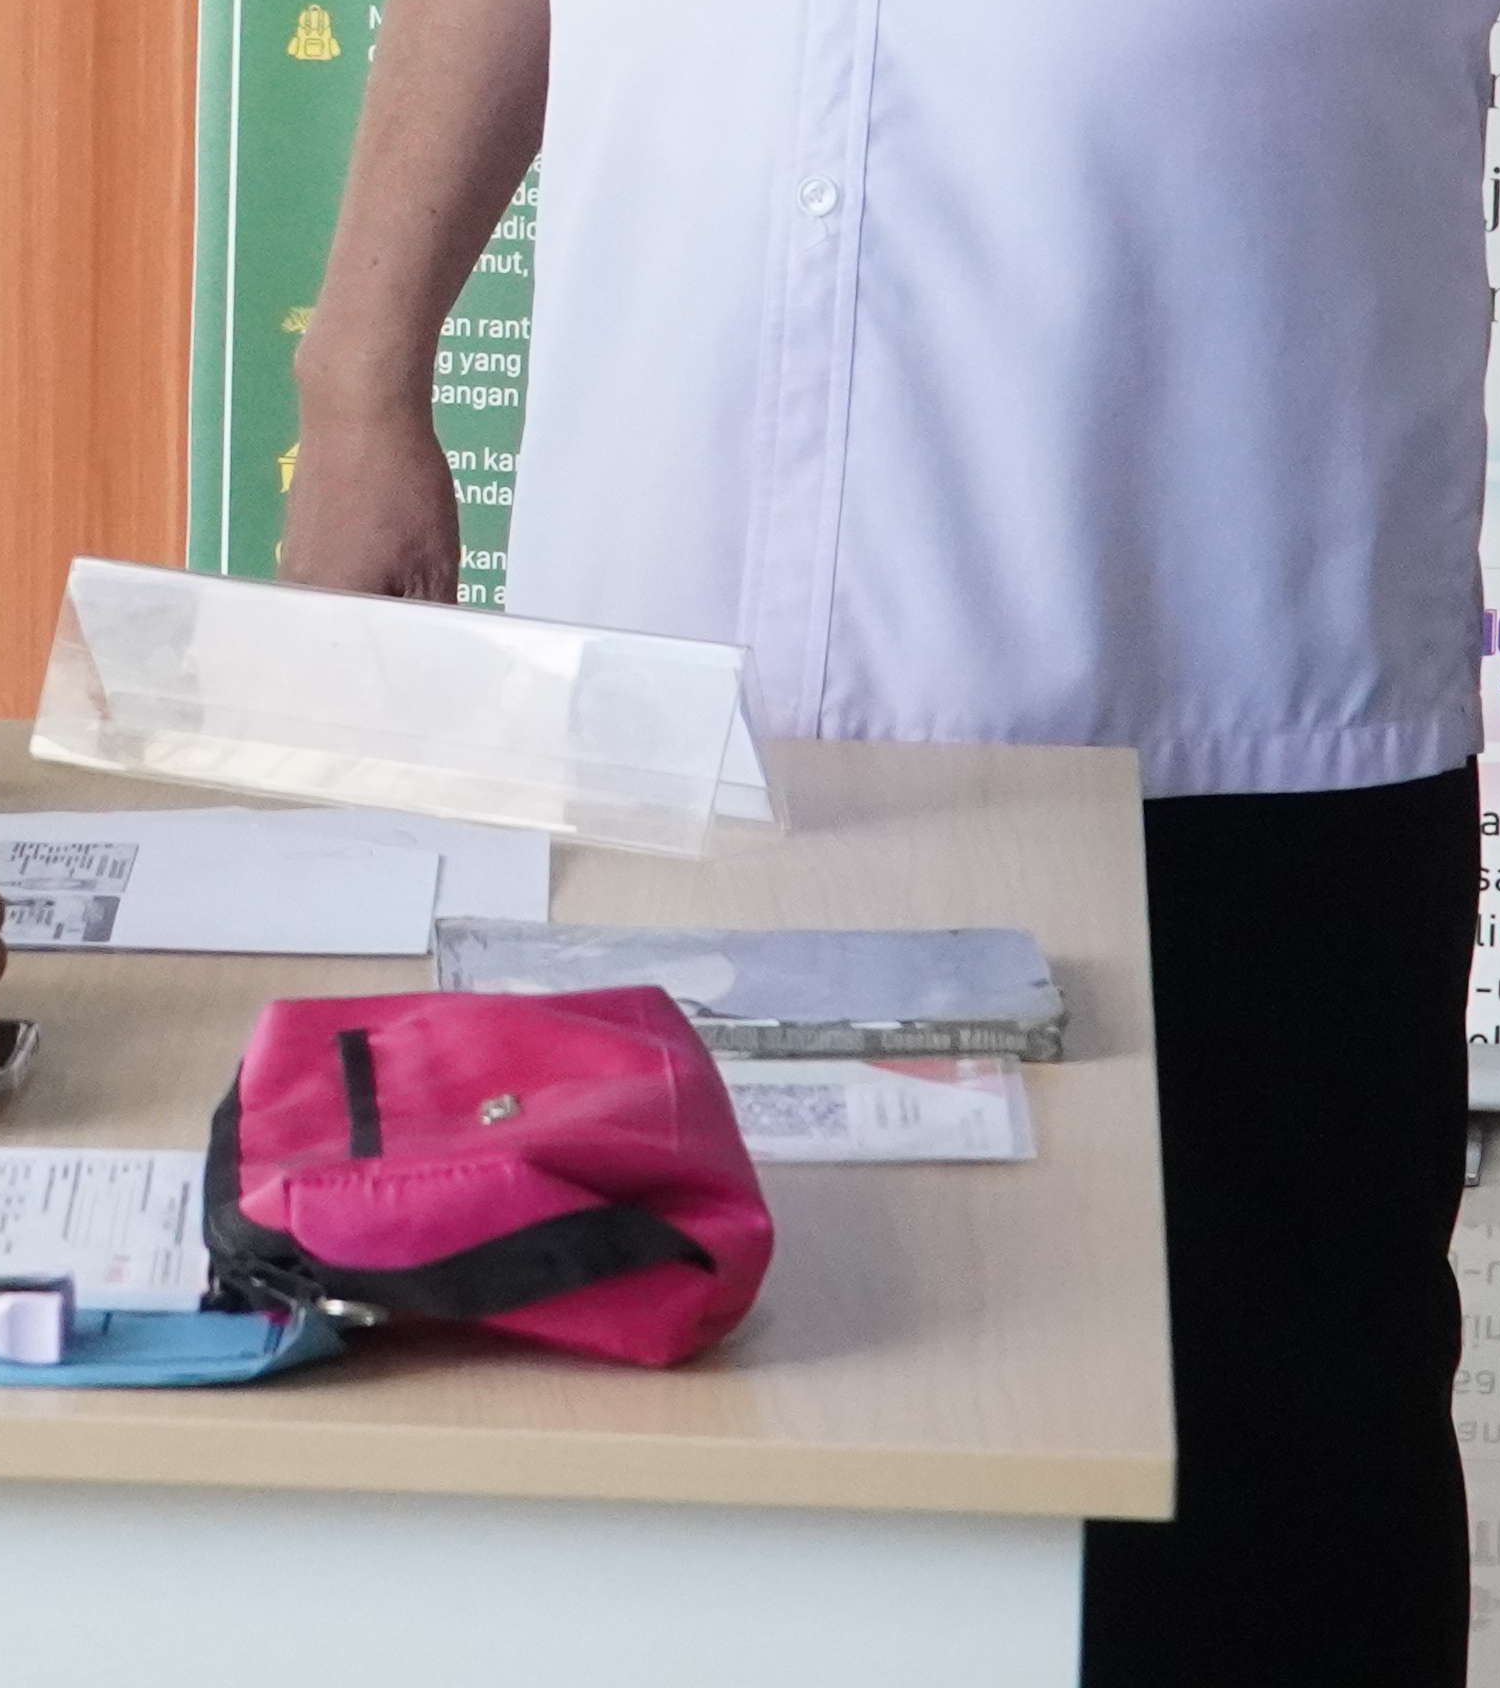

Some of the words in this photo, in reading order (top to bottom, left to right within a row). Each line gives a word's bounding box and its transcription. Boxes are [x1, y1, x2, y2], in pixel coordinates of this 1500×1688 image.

[441, 318, 471, 339] an
[460, 350, 522, 378] yang
[447, 451, 477, 472] an
[461, 547, 507, 571] kan
[457, 582, 487, 604] an
